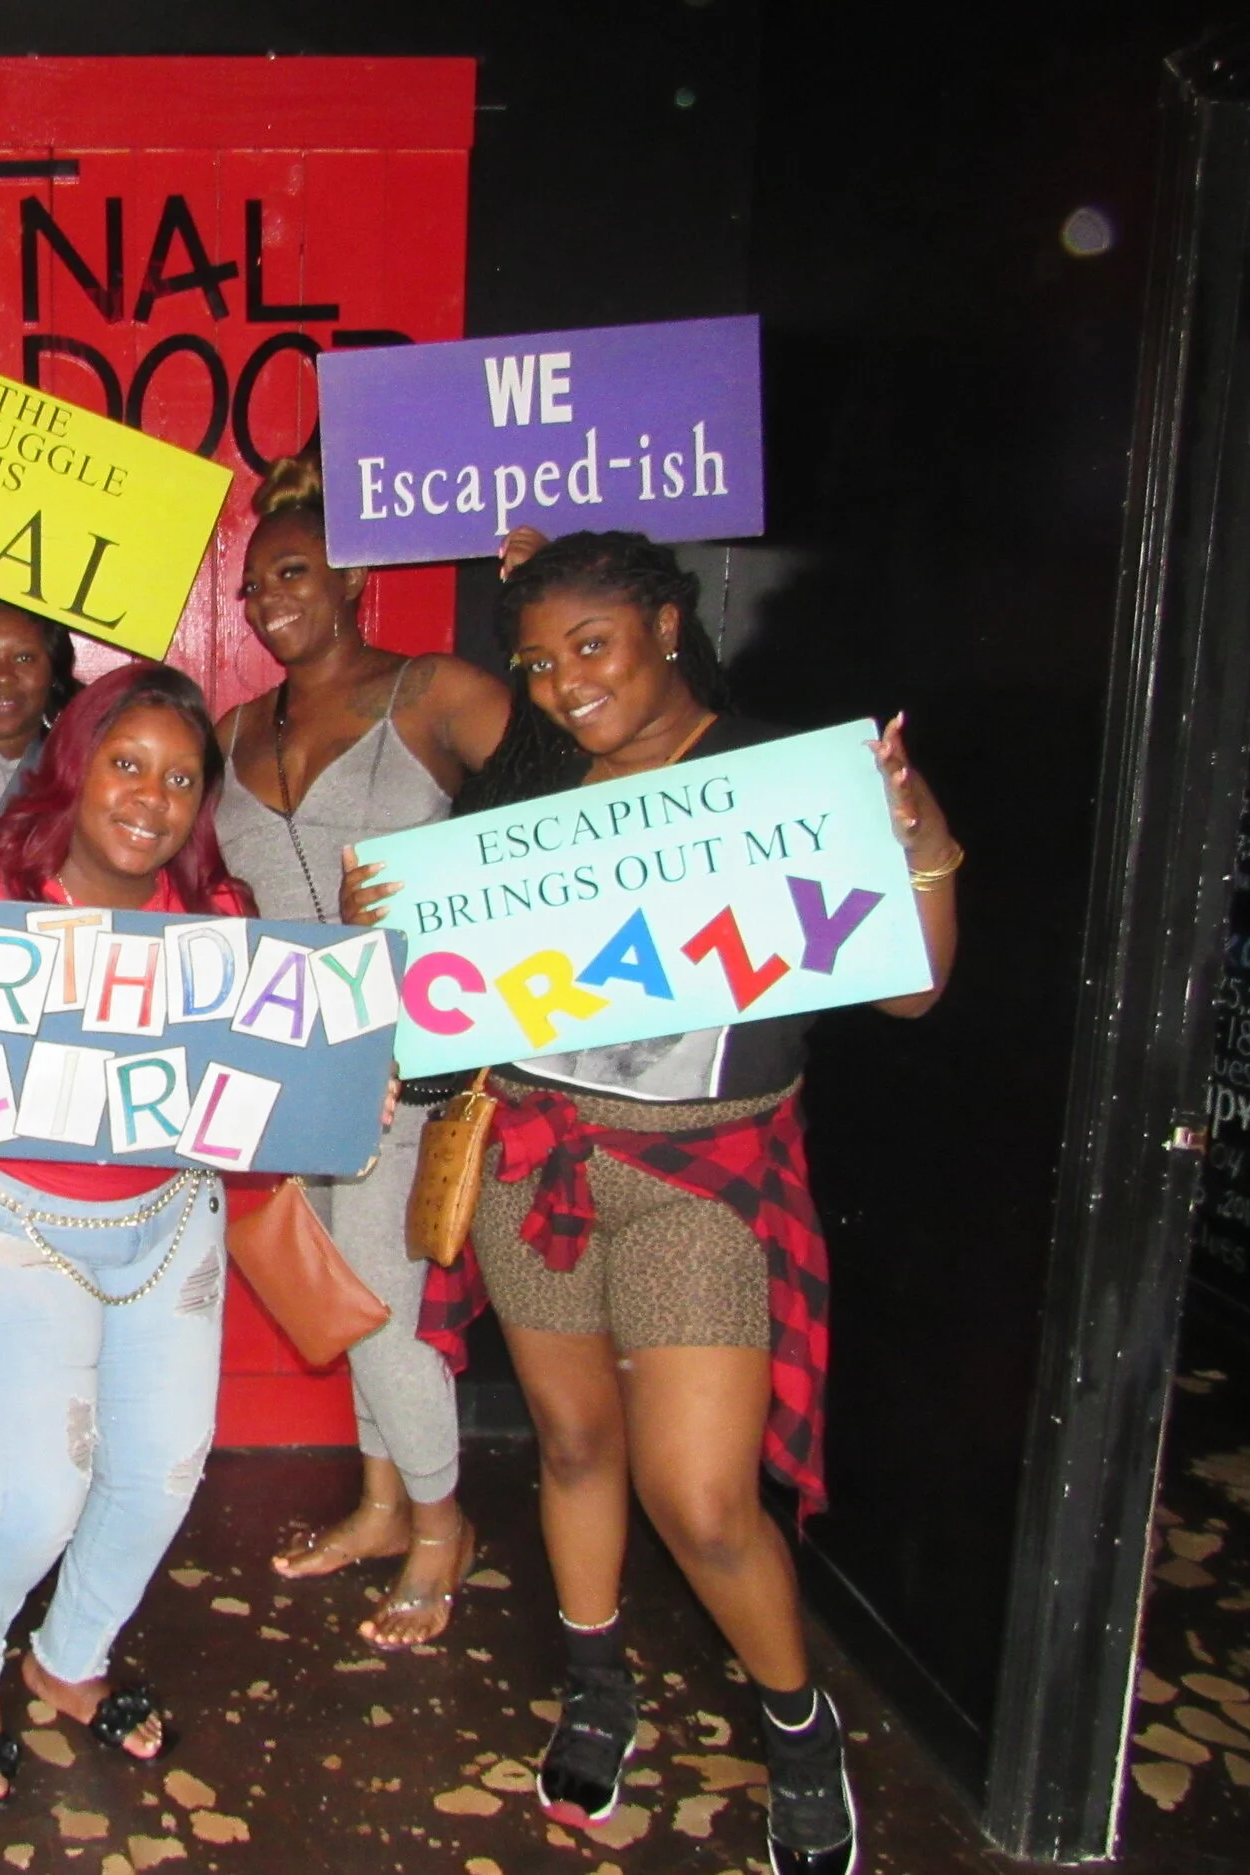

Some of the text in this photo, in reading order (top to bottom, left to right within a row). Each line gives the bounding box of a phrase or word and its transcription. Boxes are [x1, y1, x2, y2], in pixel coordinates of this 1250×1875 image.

[22, 331, 420, 478] DOO
[484, 352, 573, 427] WE
[358, 421, 729, 536] Escaped-ish
[414, 812, 832, 935] BRINGS OUT MY
[476, 775, 737, 867] ESCAPING
[401, 874, 887, 1049] CRAZY
